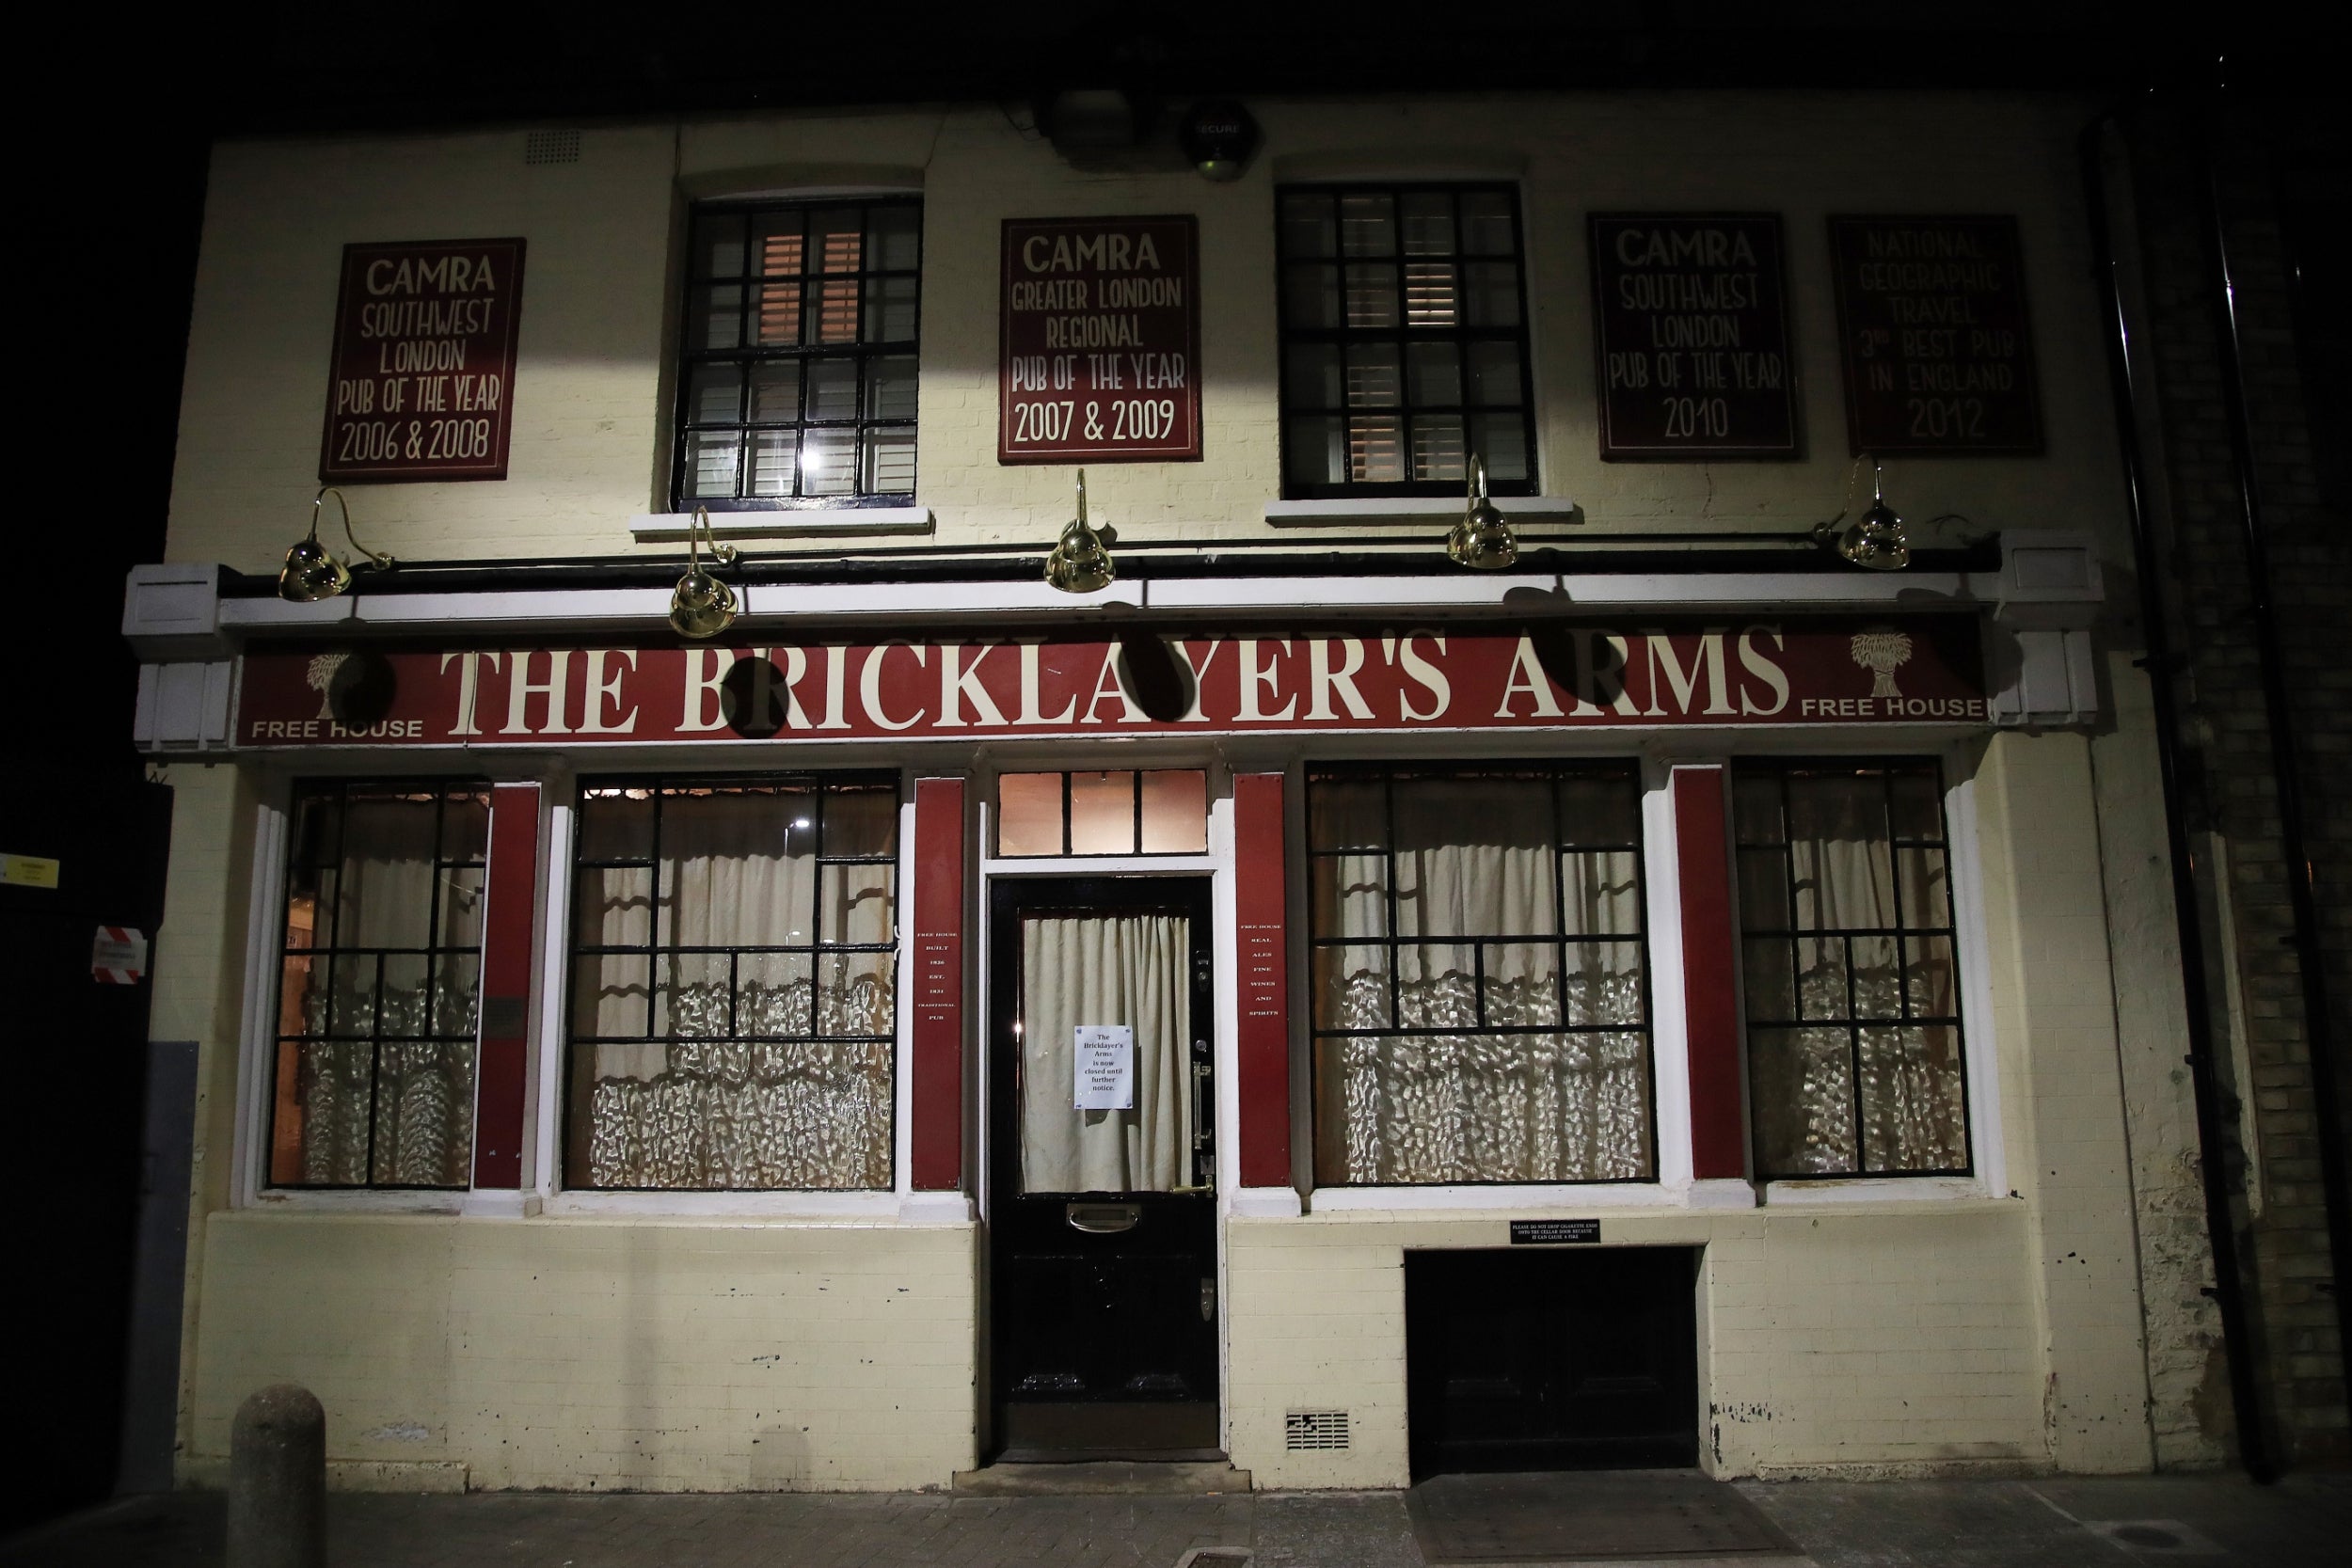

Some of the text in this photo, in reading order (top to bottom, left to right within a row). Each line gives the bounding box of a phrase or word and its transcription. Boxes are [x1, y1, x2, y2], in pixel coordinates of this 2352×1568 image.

[1023, 232, 1162, 274] CAMRA
[1615, 228, 1758, 269] CAMRA
[1866, 229, 1986, 259] NATIONAL
[366, 253, 497, 296] CAMRA
[1010, 276, 1183, 311] GREATER LONDON
[1618, 273, 1759, 310] SOUTHWEST
[1858, 261, 2003, 293] GEOGRAPHIC
[360, 297, 495, 339] SOUTHWEST
[1885, 294, 1981, 325] TRAVEL
[1045, 313, 1145, 350] REGIONAL
[1650, 314, 1741, 349] LONDON
[1859, 328, 2017, 359] 3RD BEST PUB
[378, 338, 467, 374] LONDON
[1011, 352, 1186, 393] PUB OF THE YEAR
[1609, 351, 1784, 390] PUB OF THE YEAR
[337, 373, 501, 416] PUB OF THE YEAR
[1867, 362, 2015, 392] IN ENGLAND
[1014, 399, 1176, 442] 2007 & 2009
[1661, 396, 1730, 438] 2010
[1906, 396, 1987, 438] 2012
[339, 419, 491, 462] 2006 & 2008
[439, 623, 1790, 736] THE BRICKLAYER'S ARMS
[1801, 697, 1984, 717] FREE HOUSE
[251, 719, 424, 738] FREE HOUSE
